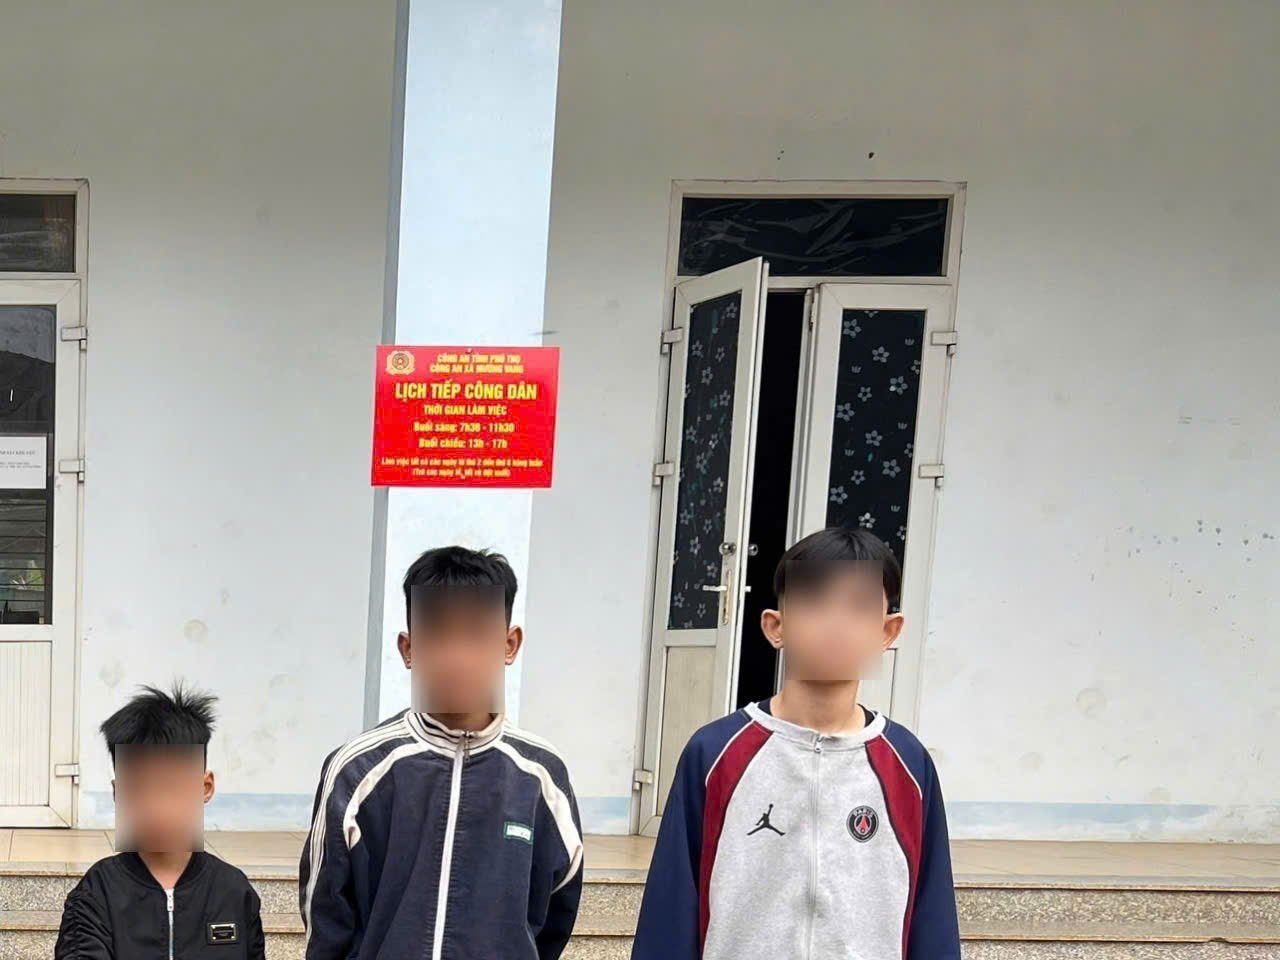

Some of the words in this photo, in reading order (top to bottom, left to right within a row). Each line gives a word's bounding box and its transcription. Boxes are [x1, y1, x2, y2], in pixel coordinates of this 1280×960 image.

[395, 382, 427, 402] LỊCH
[431, 379, 460, 399] TIẾP
[465, 380, 504, 399] CÔNG
[507, 381, 537, 399] DÂN
[445, 405, 465, 415] GIAN
[467, 404, 486, 415] LÀM
[460, 422, 480, 432] 7h30
[489, 422, 515, 433] 11h30
[468, 439, 484, 448] 13h
[492, 439, 508, 449] 17h
